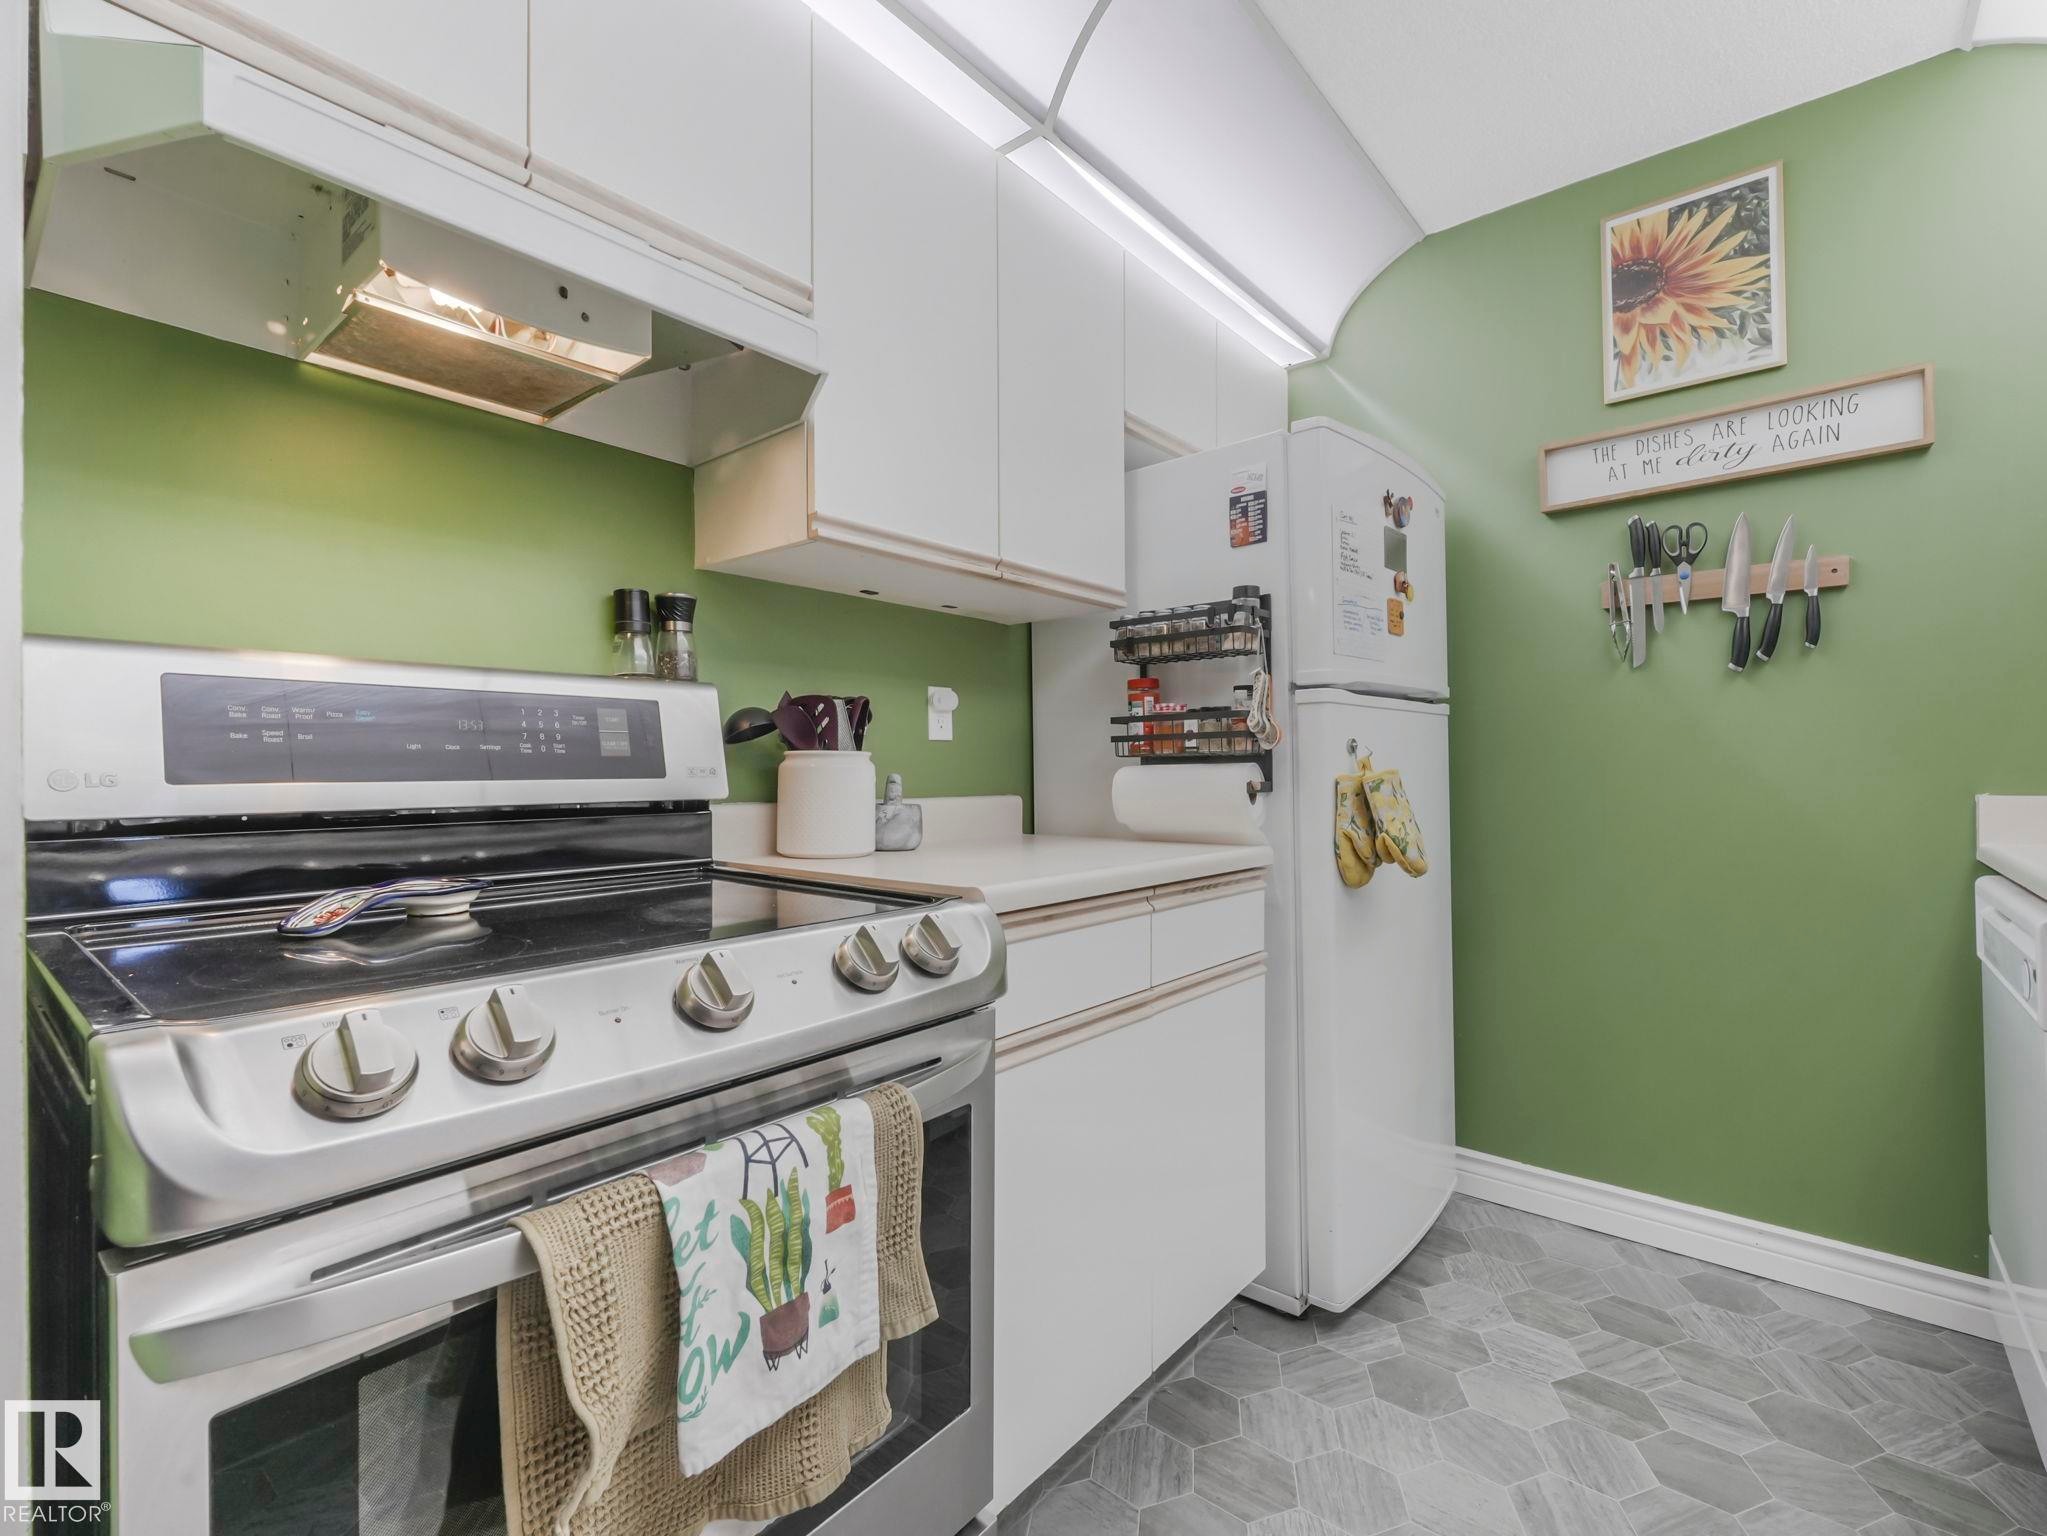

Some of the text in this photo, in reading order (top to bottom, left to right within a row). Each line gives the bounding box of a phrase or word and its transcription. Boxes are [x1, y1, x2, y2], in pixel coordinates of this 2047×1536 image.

[1592, 393, 1860, 464] THE DISHES ARE LOOKING
[1608, 422, 1841, 482] AT ME dirty AGAIN
[537, 708, 543, 717] 2
[553, 709, 560, 717] 3
